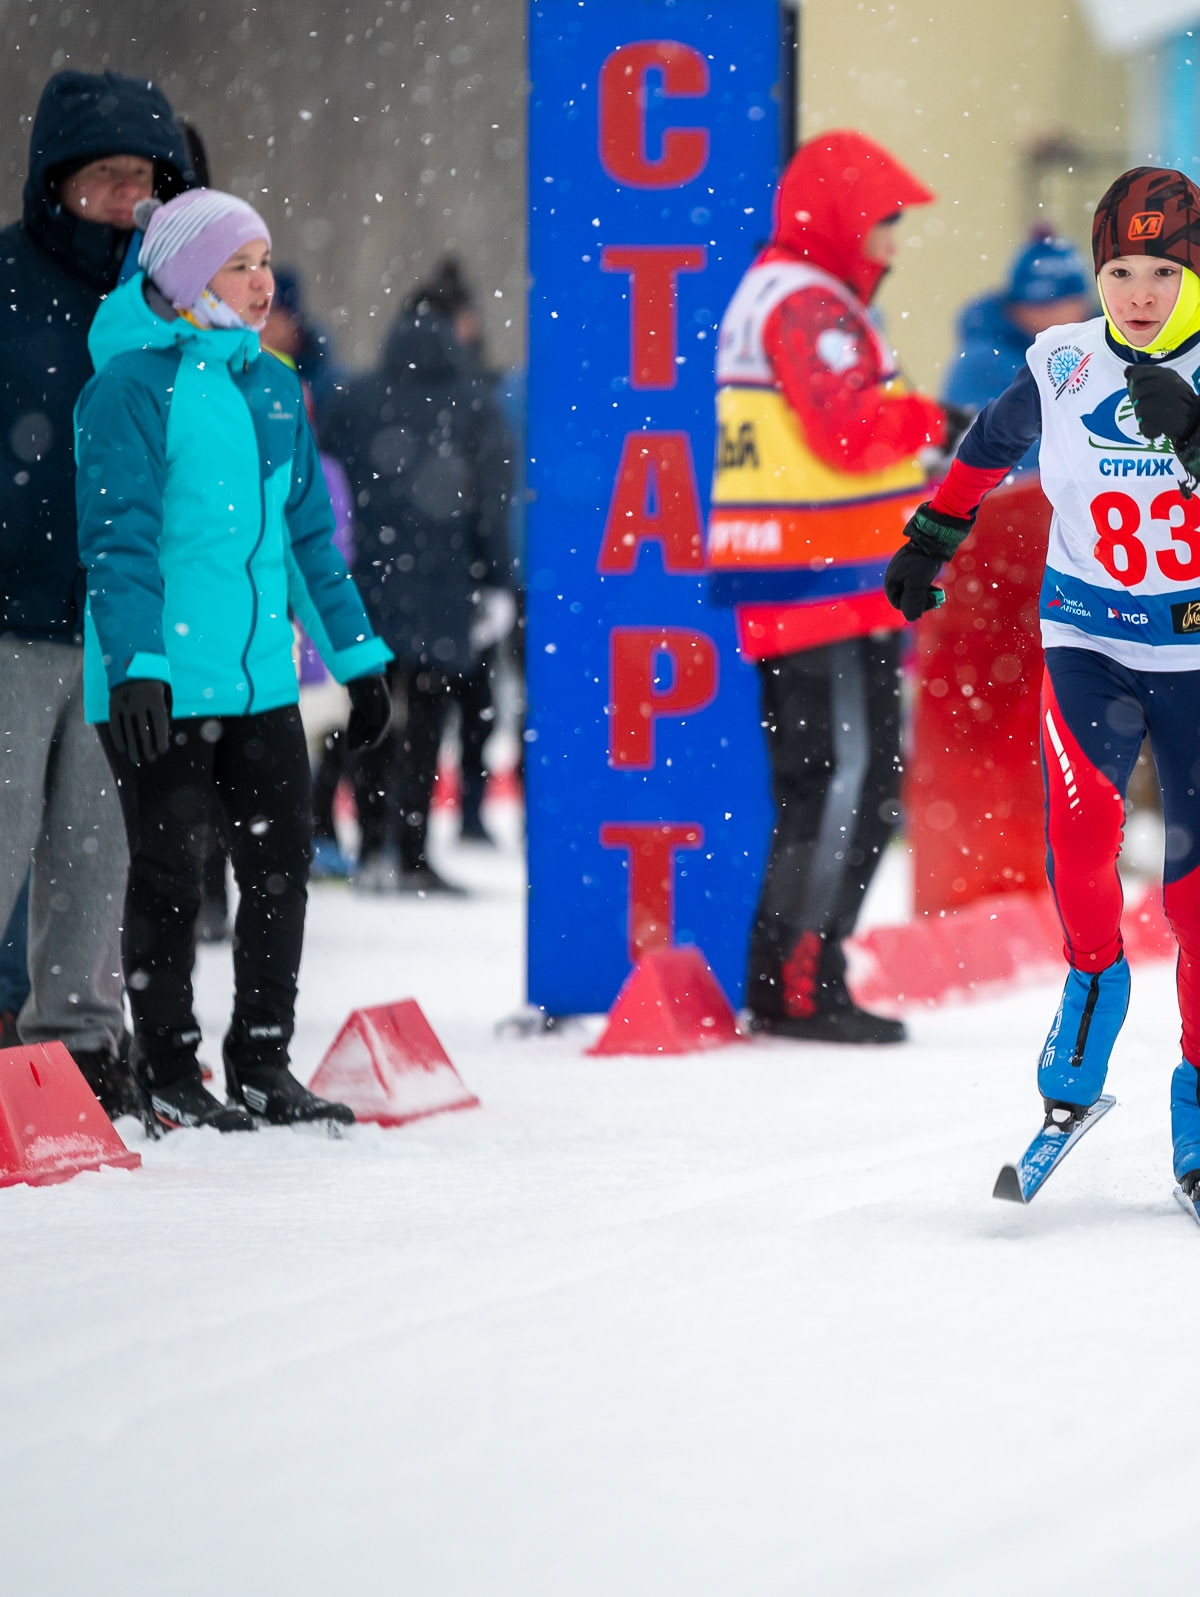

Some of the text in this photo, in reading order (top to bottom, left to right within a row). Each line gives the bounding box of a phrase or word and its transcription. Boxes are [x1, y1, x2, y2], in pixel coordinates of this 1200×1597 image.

[1098, 458, 1175, 477] СТРИЖ
[599, 40, 719, 962] СТАРТ
[1121, 612, 1149, 625] ПСБ
[1042, 993, 1066, 1069] PINE
